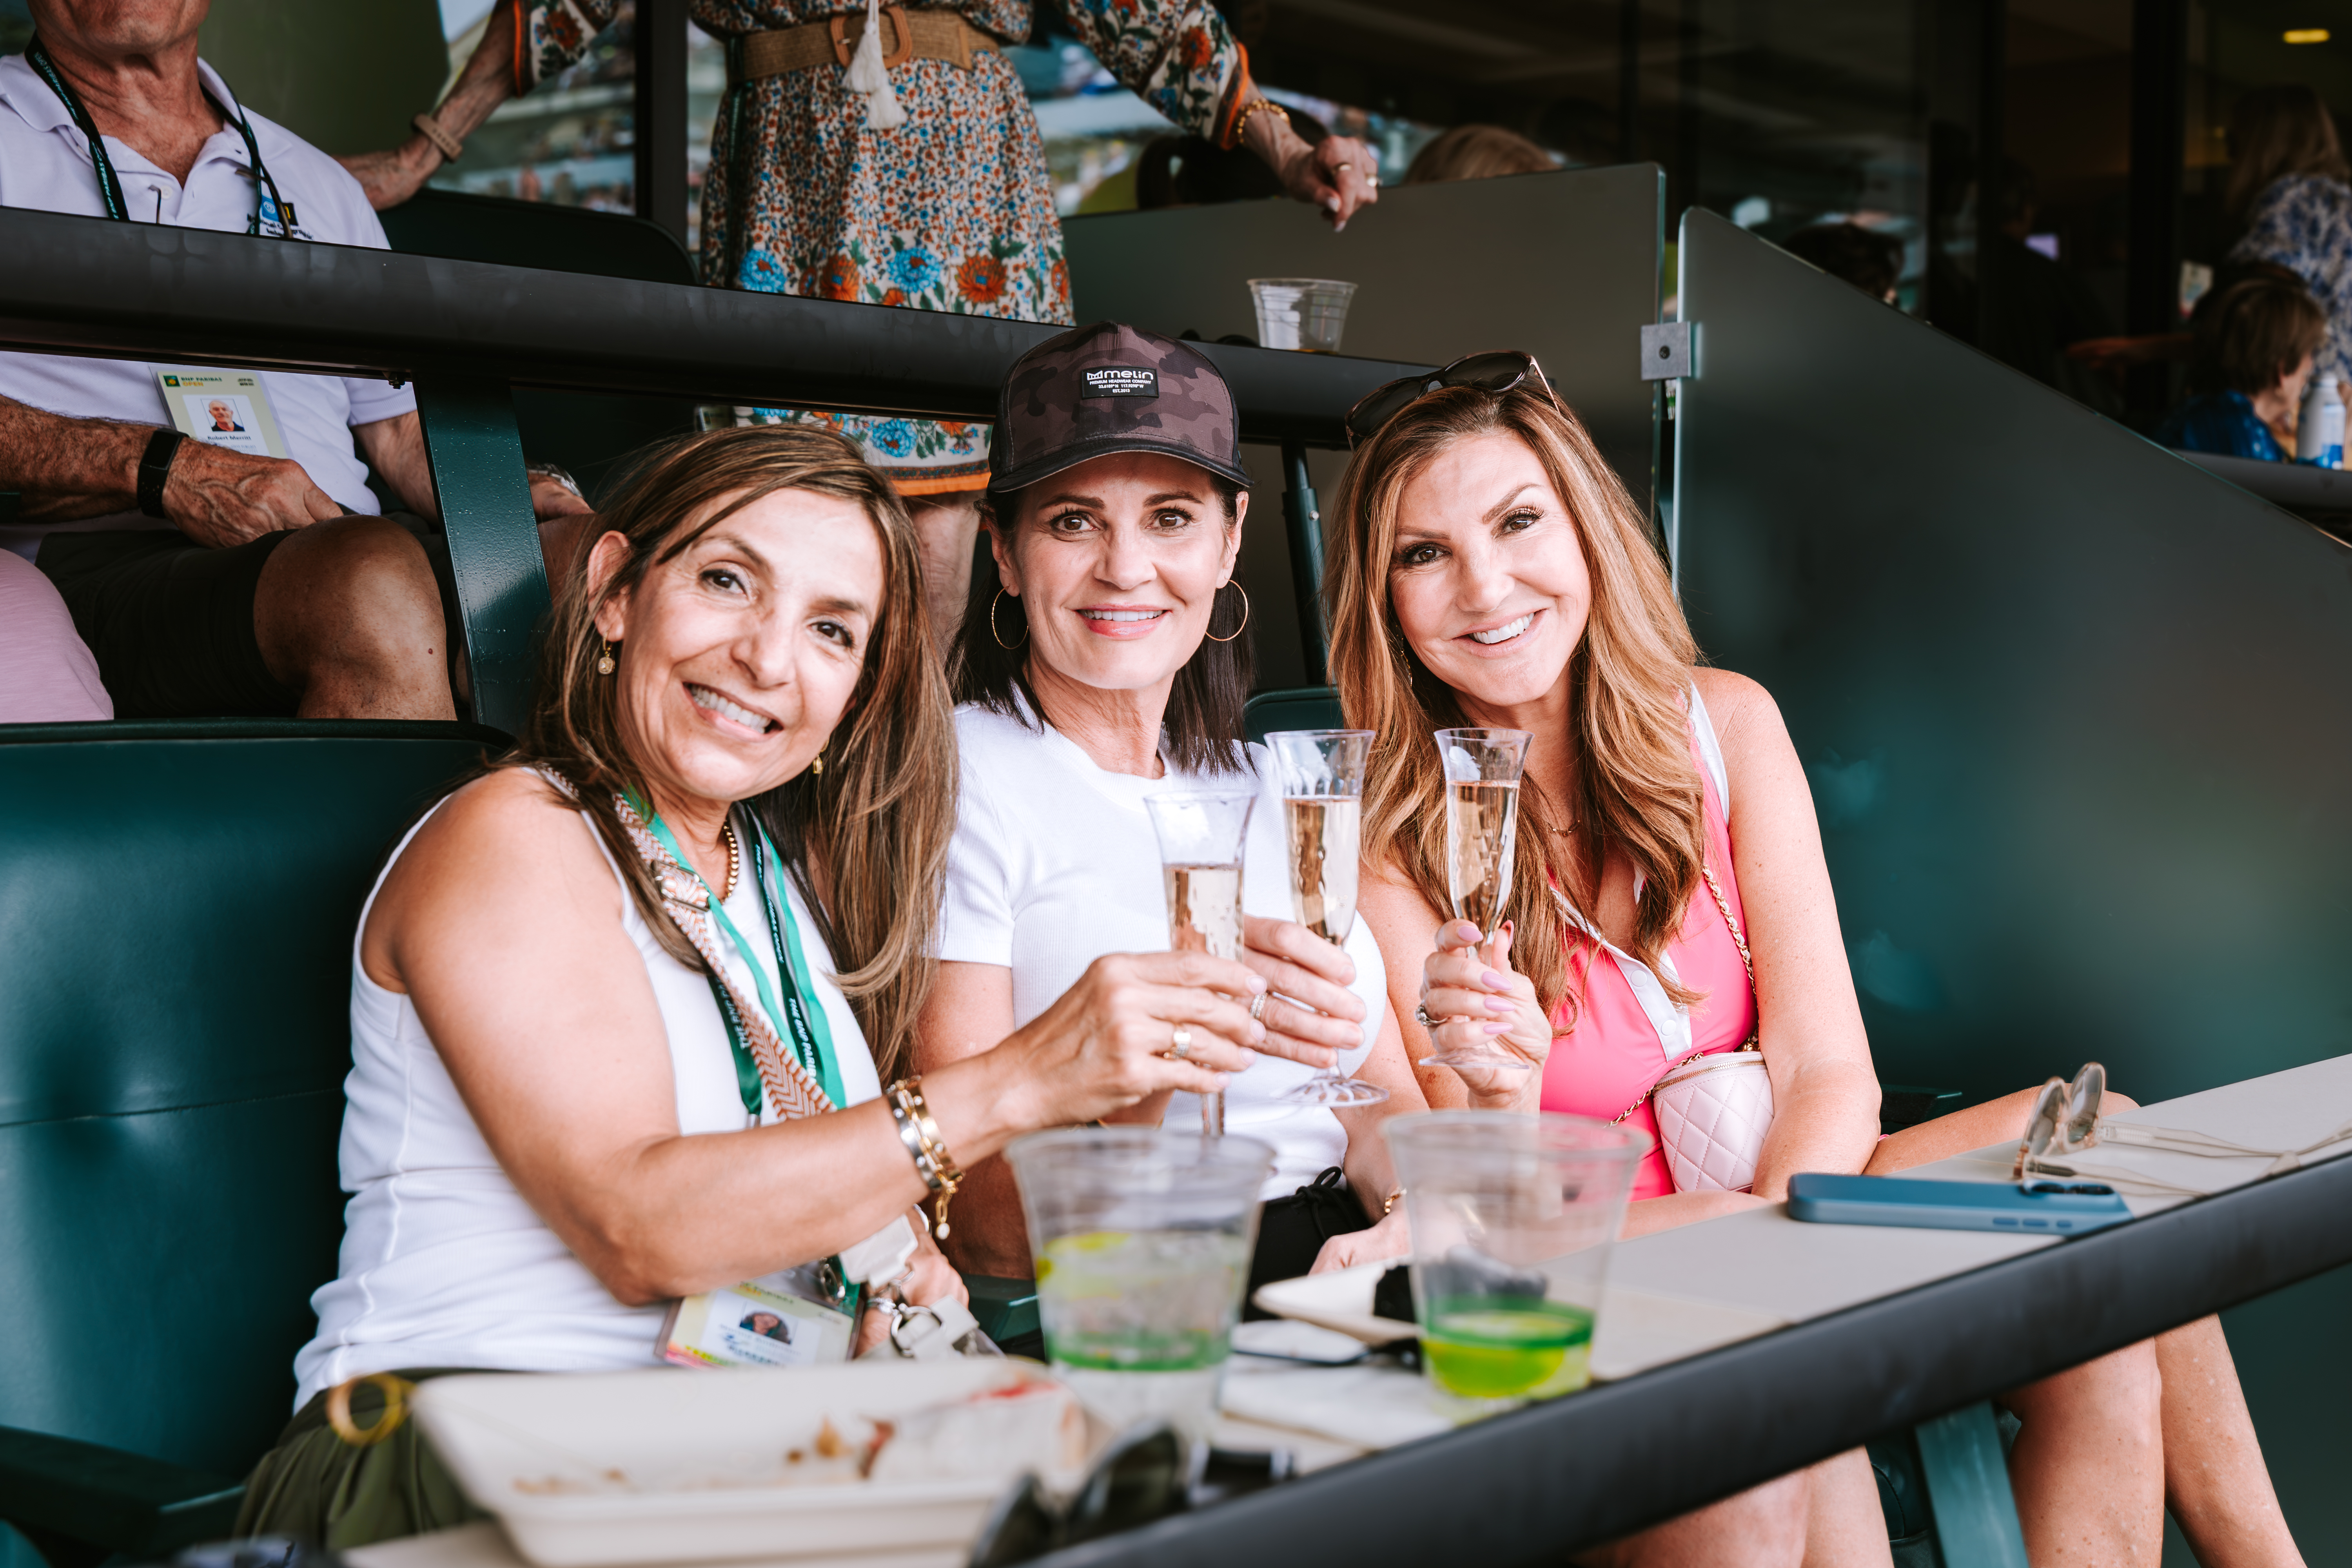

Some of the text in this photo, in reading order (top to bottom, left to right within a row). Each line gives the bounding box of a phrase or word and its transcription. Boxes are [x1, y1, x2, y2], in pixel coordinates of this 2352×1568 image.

[99, 162, 111, 196] PARIBAS
[1104, 370, 1154, 380] melin
[724, 1000, 751, 1050] THE BNP
[788, 997, 817, 1083] THE BNP PARIB
